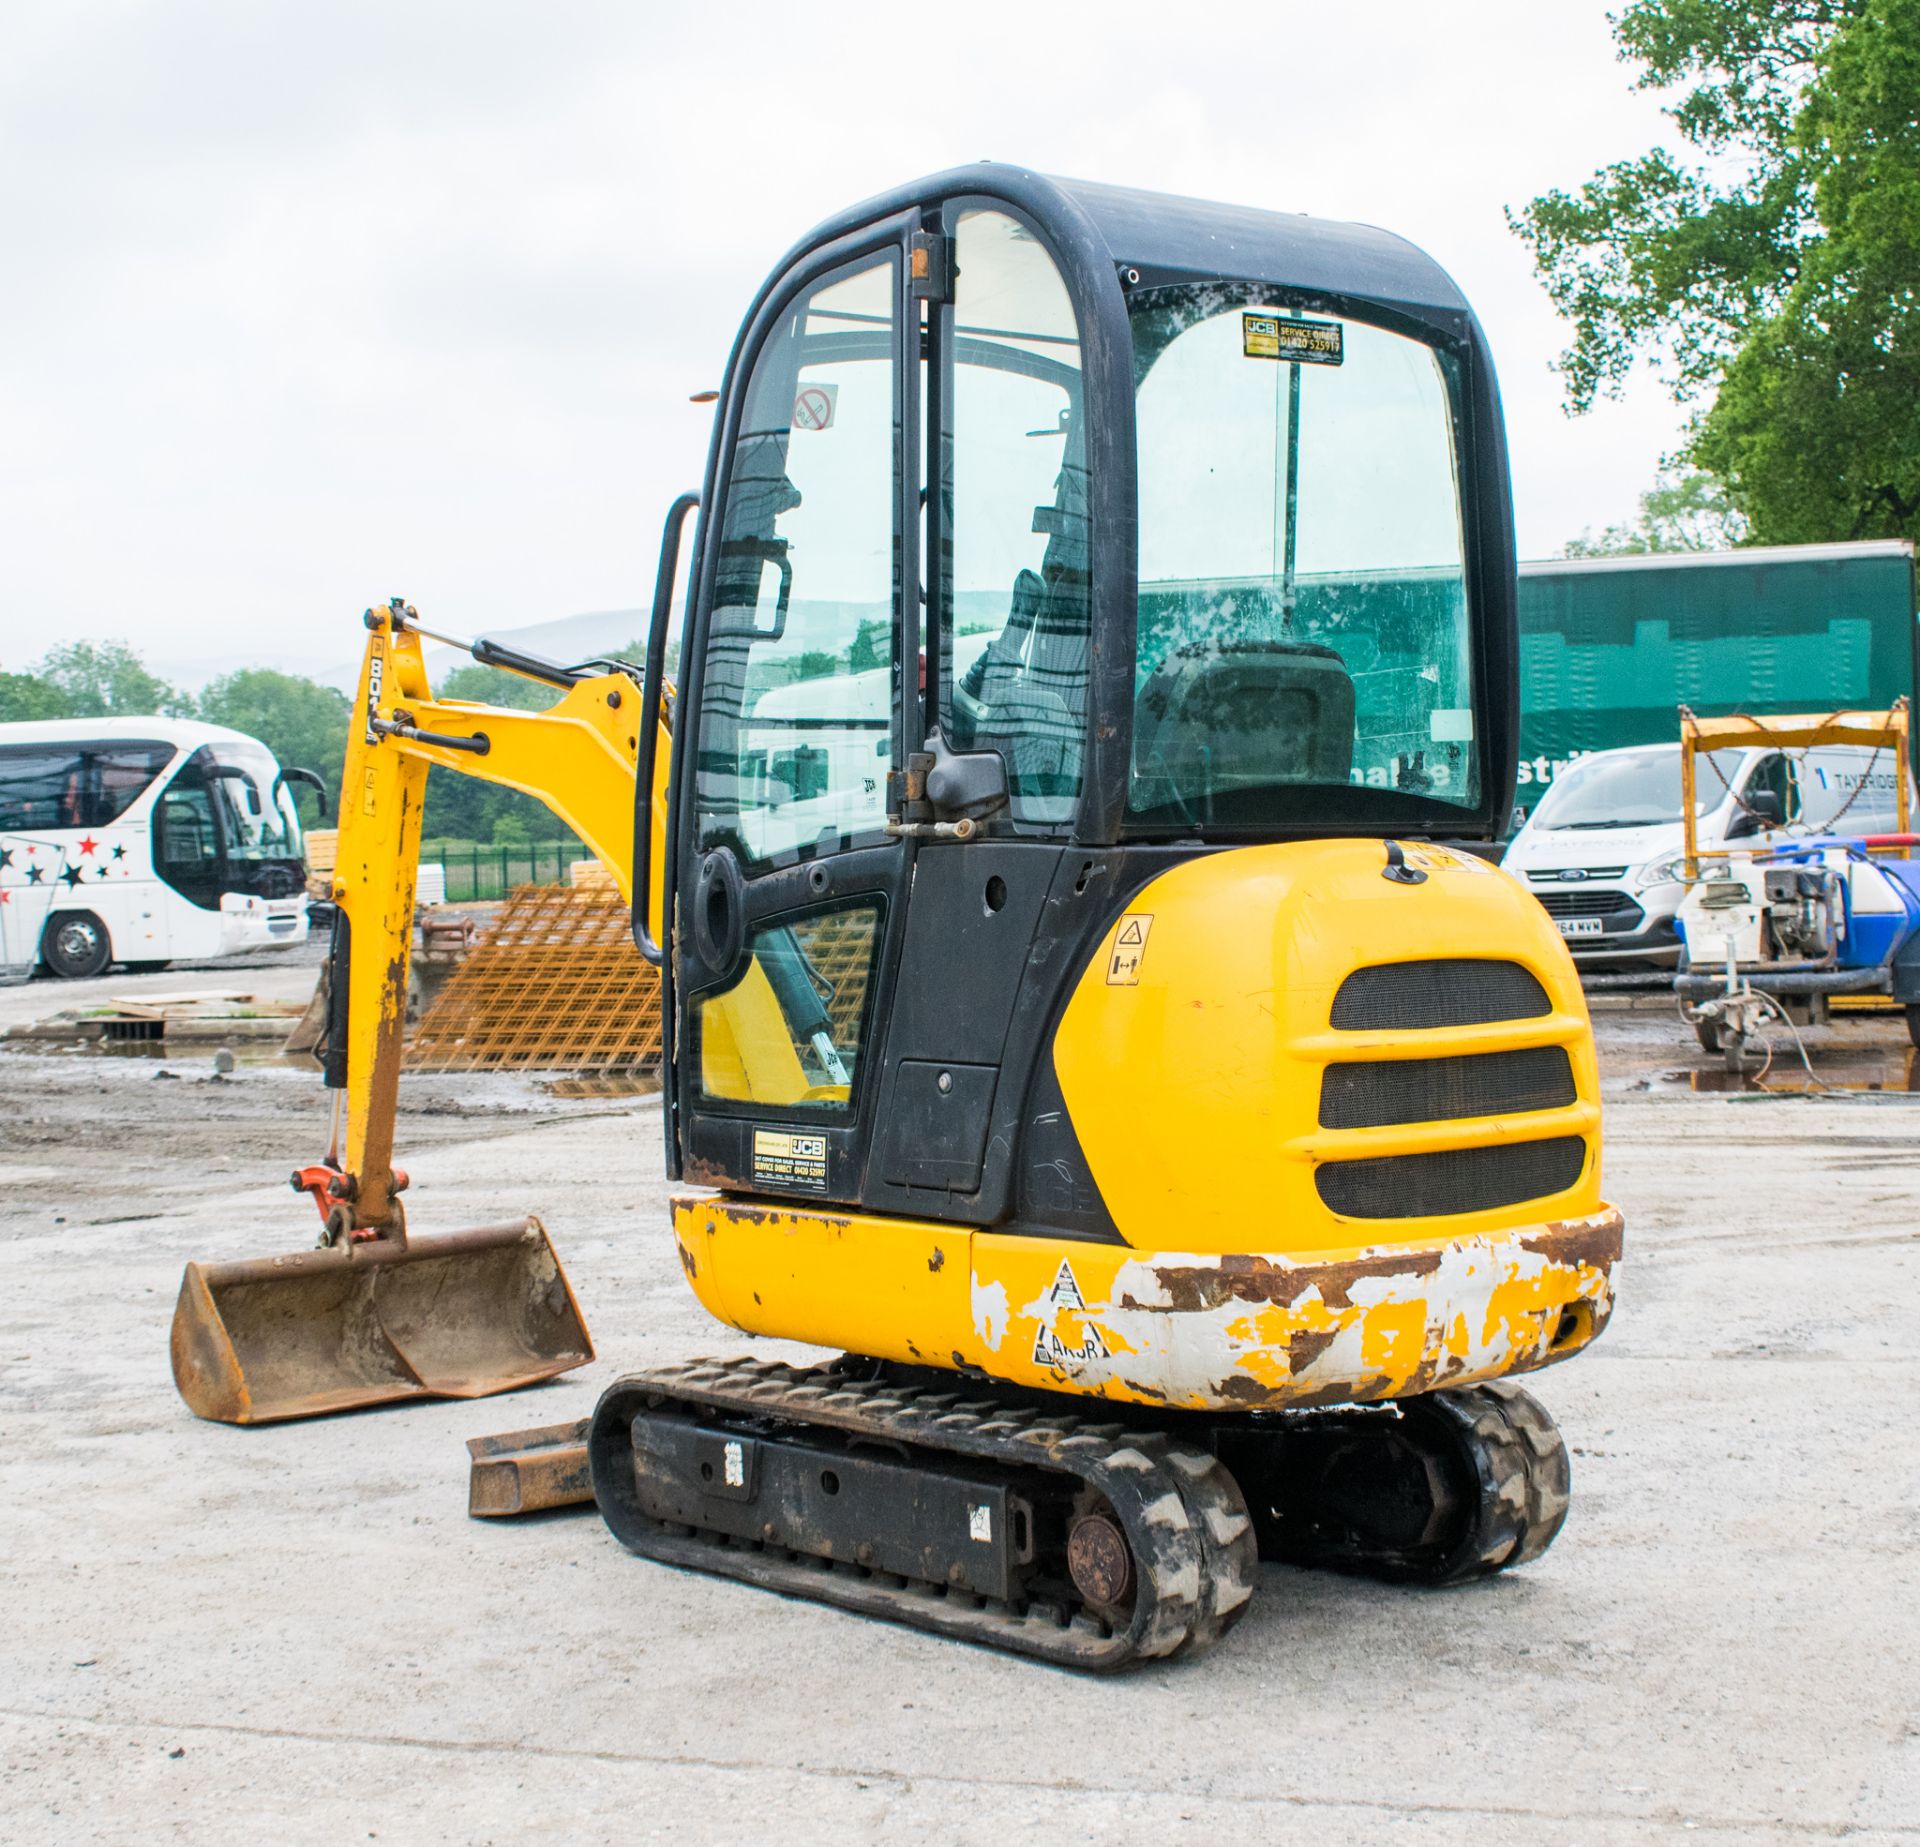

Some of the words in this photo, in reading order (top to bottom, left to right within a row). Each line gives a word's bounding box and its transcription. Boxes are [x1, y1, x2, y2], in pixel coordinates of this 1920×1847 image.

[1248, 322, 1276, 335] JCB
[1281, 328, 1312, 339] SERVICE
[1280, 337, 1308, 349] 01420
[792, 1139, 823, 1156] JCB
[754, 1161, 774, 1172] SERVICE
[774, 1164, 792, 1174] DIRECT
